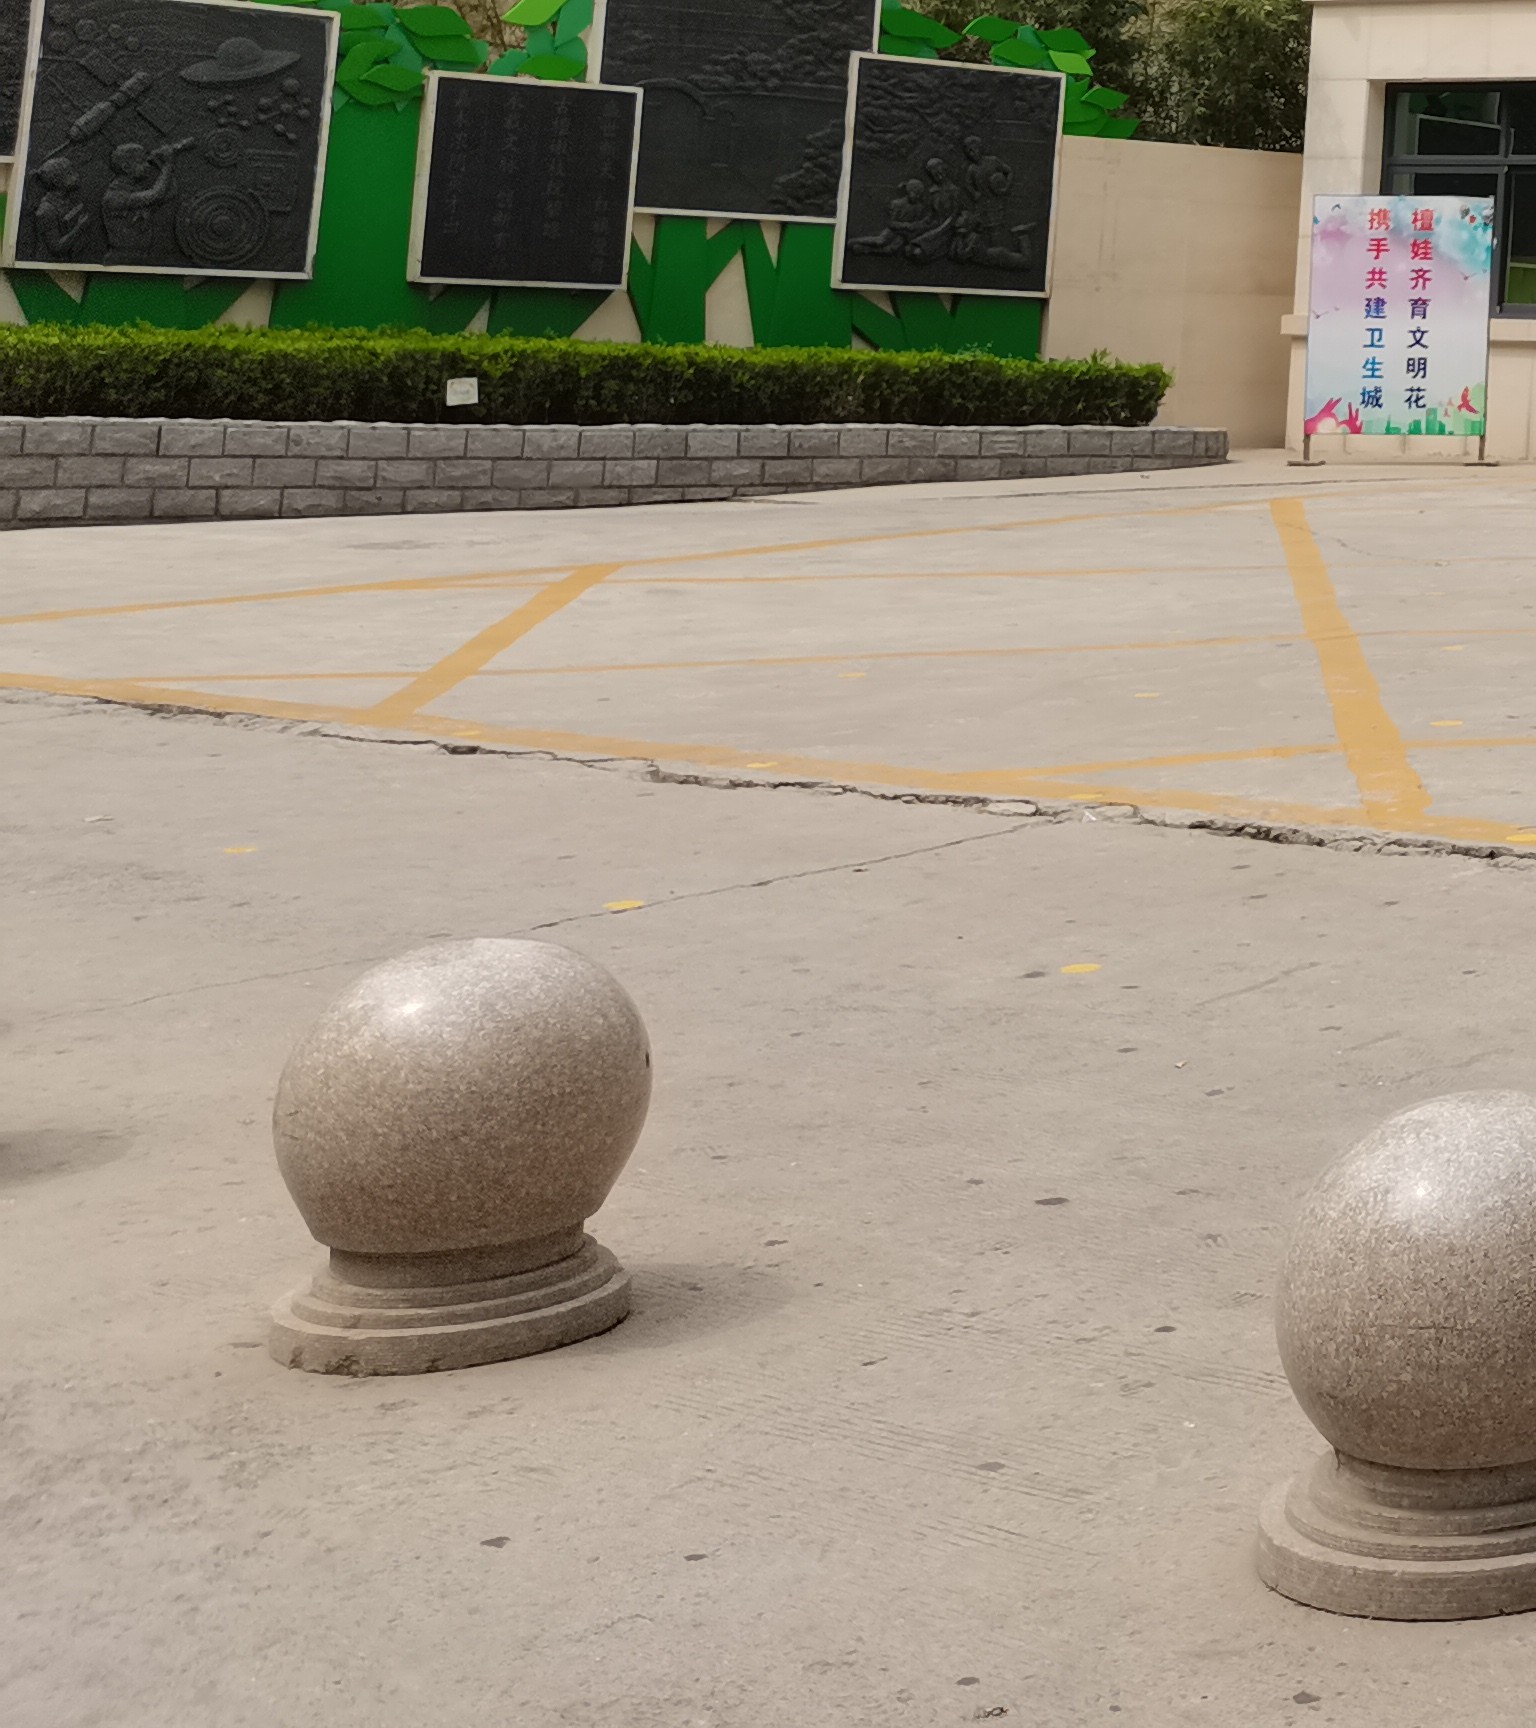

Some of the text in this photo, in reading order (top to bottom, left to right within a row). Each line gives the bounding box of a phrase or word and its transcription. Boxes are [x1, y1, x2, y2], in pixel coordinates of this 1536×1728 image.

[1359, 207, 1392, 409] 携手共建卫生城
